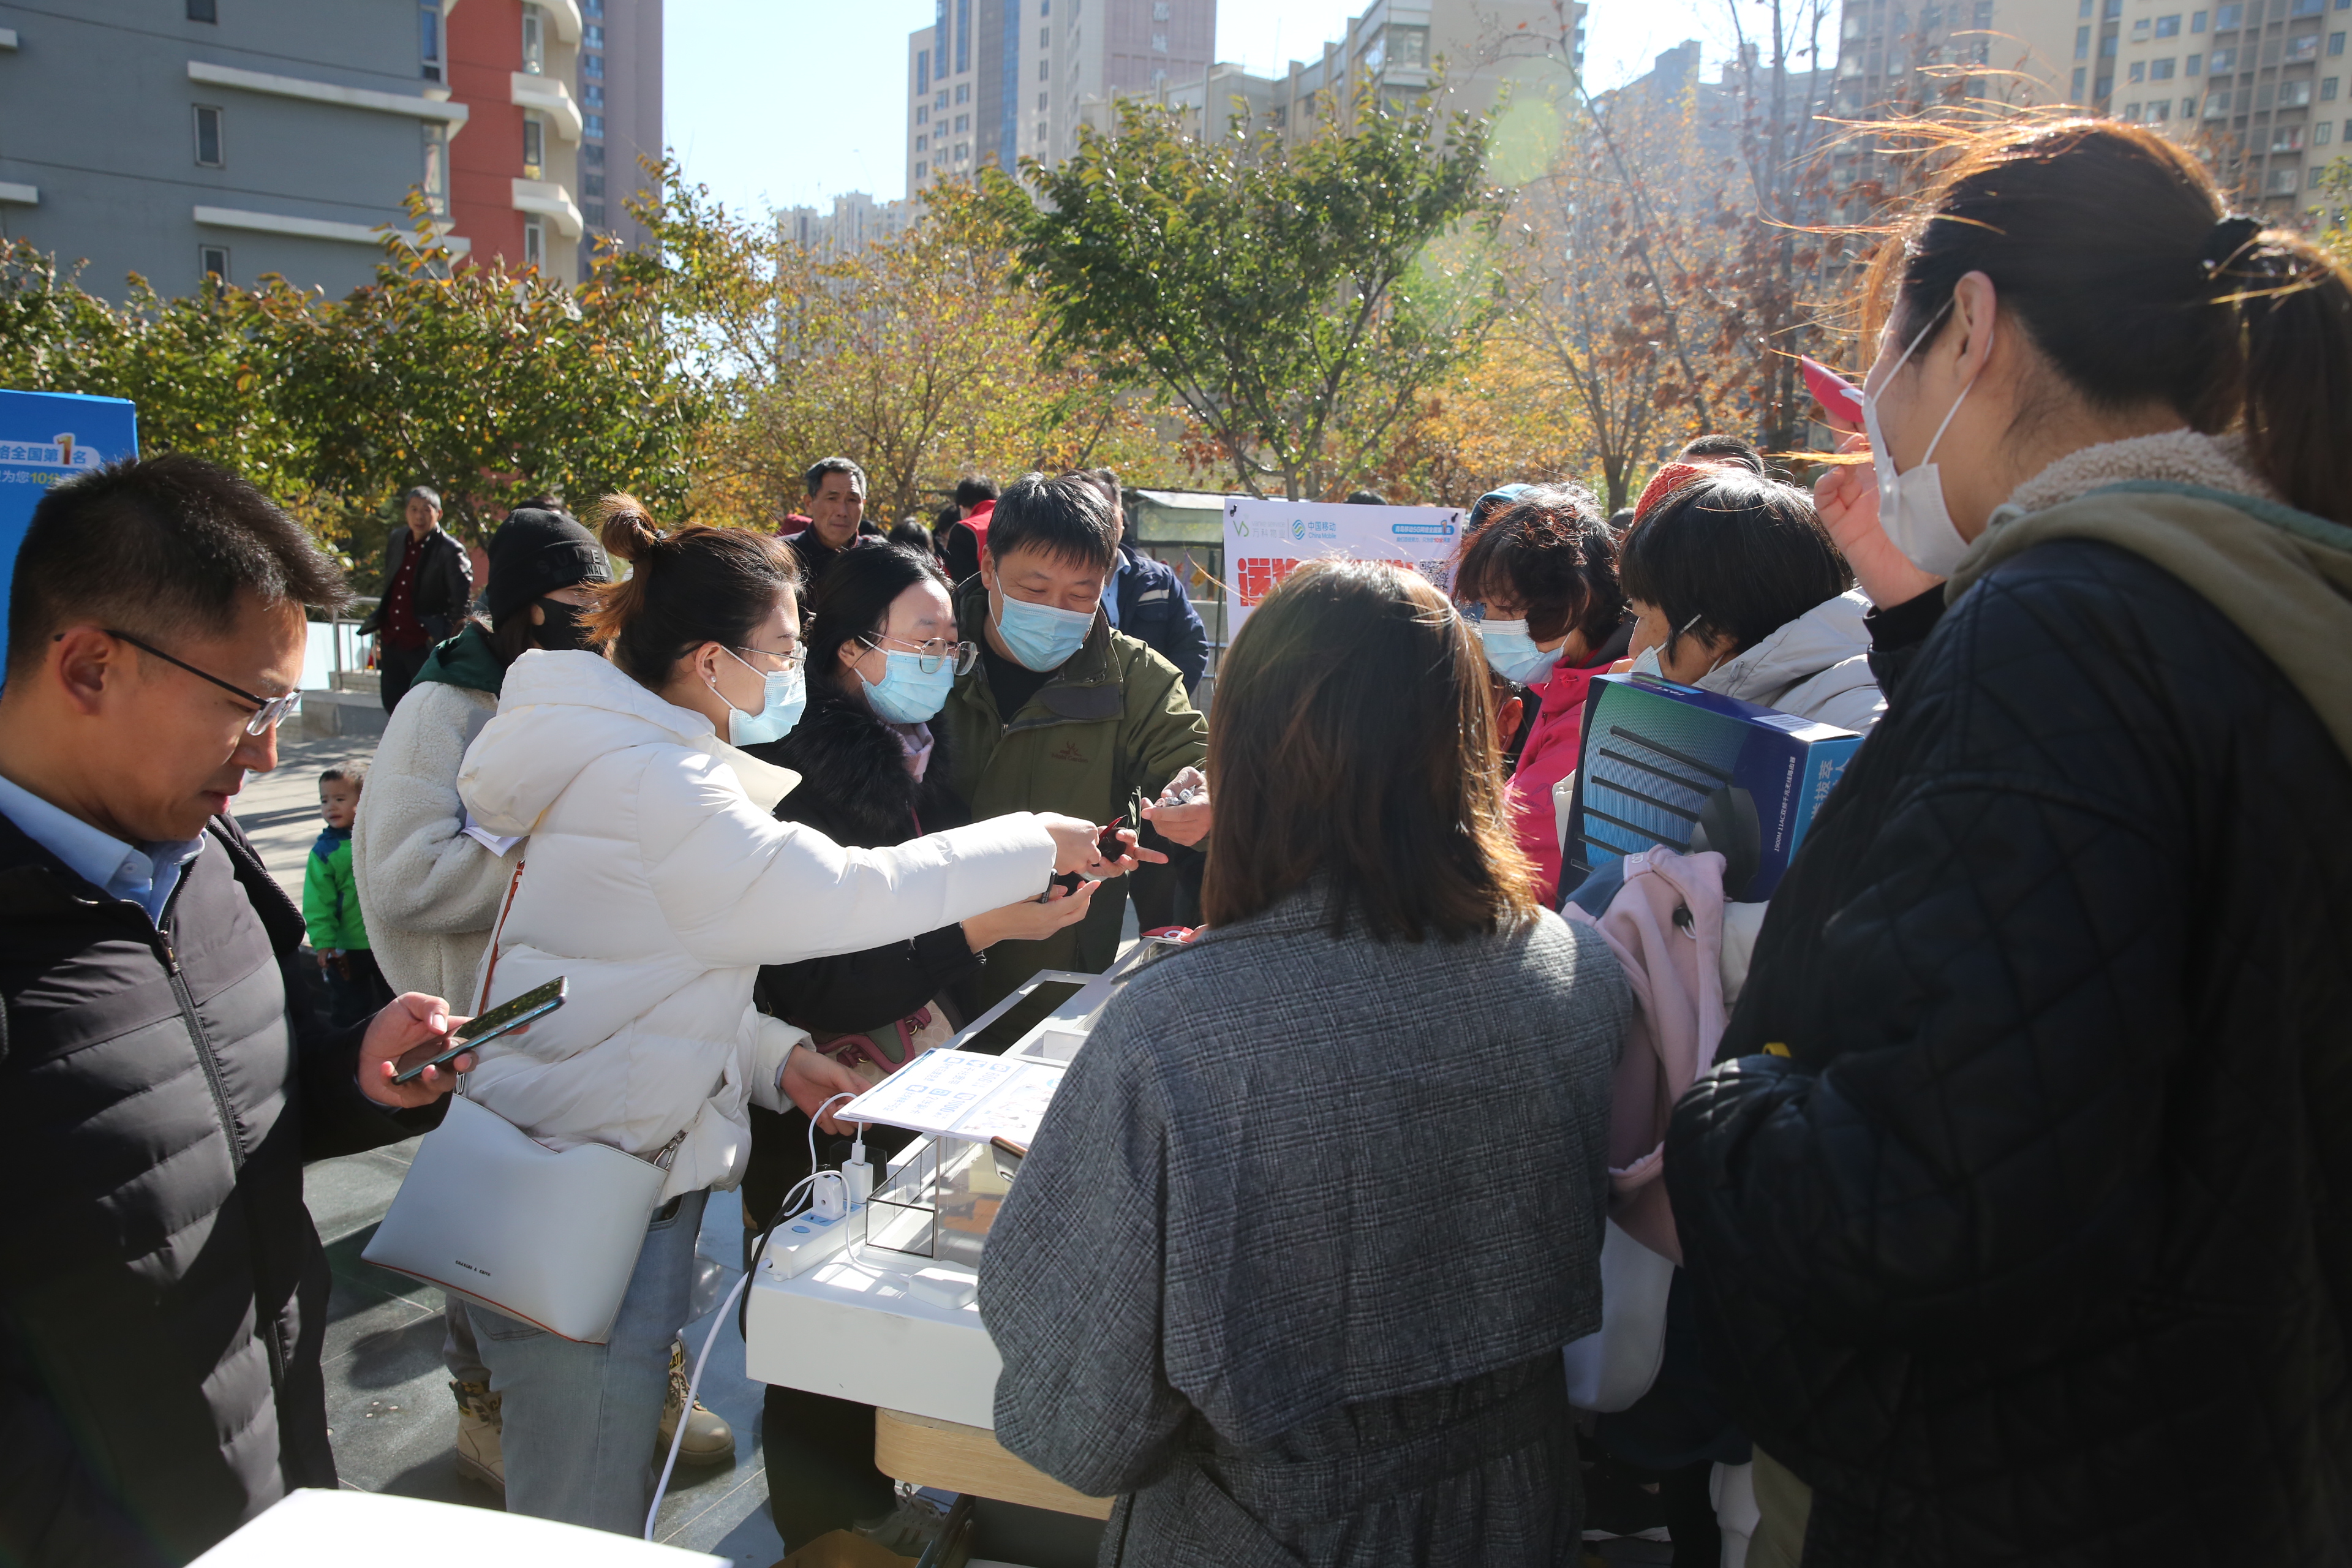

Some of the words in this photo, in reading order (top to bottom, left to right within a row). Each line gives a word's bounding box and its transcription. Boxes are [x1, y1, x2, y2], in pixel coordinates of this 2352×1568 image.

[1308, 521, 1336, 531] 中国移动
[1253, 528, 1286, 538] 万科物业
[1654, 687, 1685, 696] FAST
[1778, 756, 1796, 831] 11AC双频千兆无线路由器
